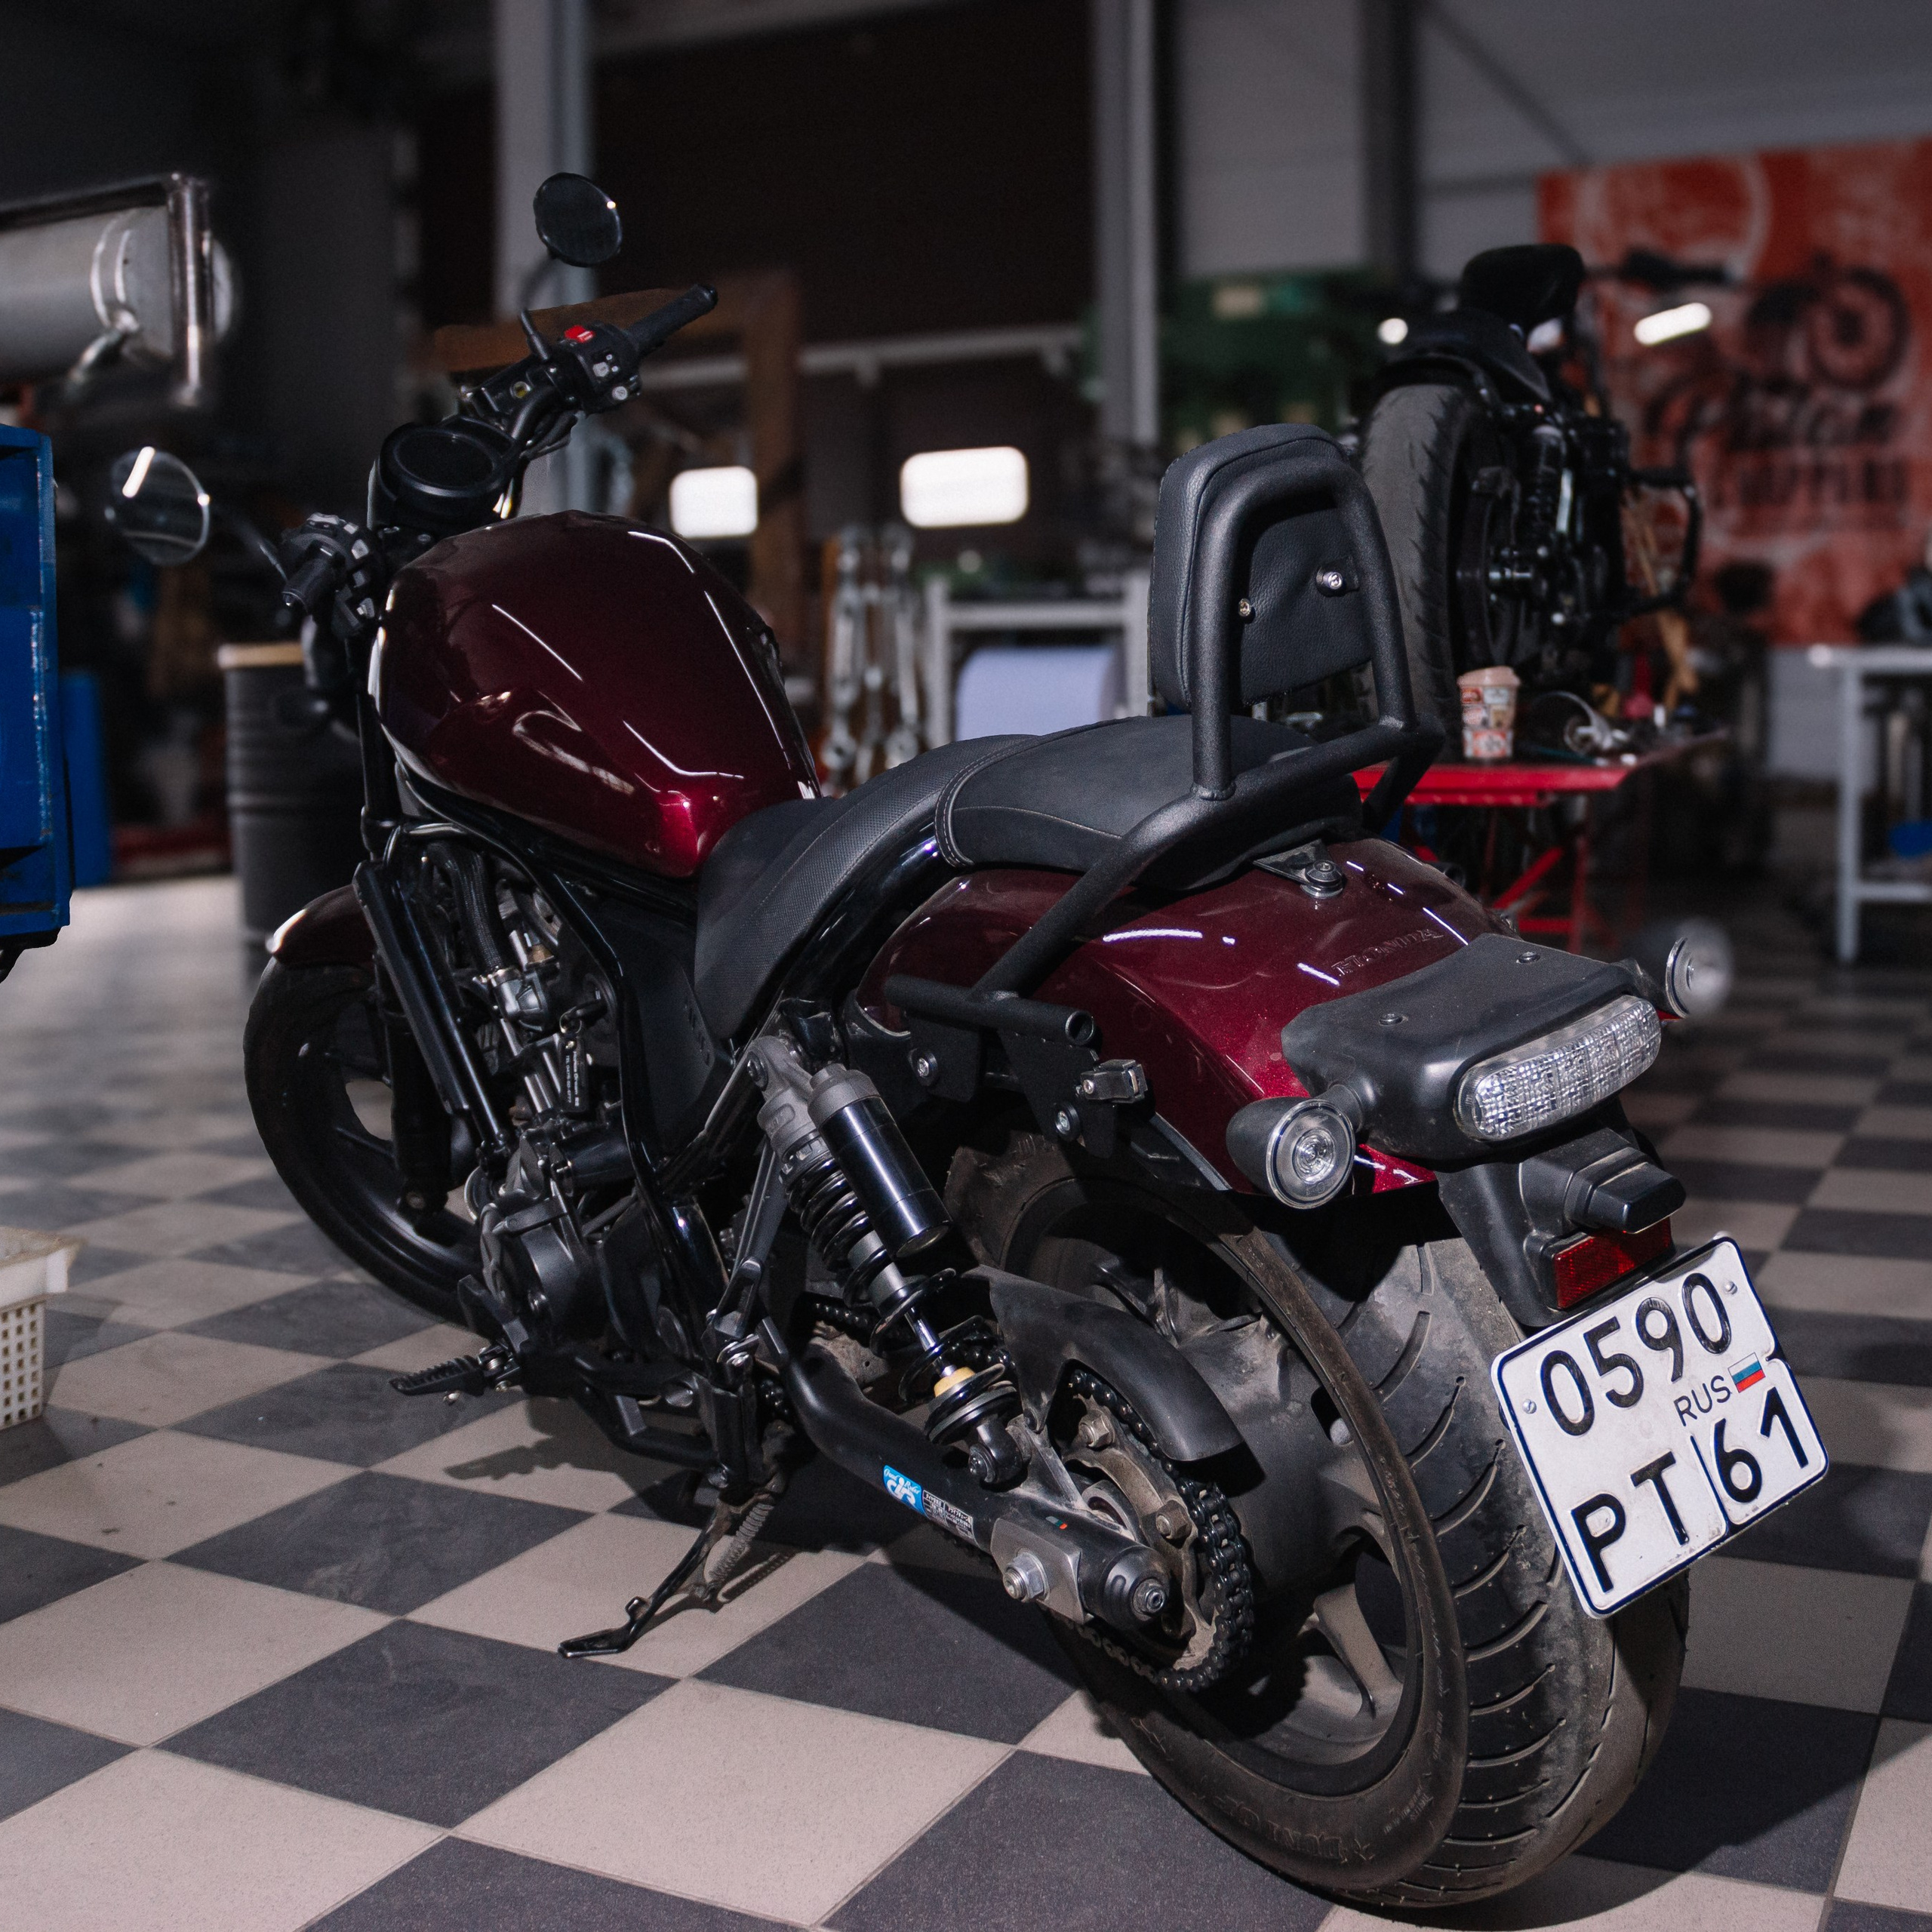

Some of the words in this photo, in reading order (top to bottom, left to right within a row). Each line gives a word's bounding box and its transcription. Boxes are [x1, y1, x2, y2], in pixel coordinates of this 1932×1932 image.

[1540, 1272, 1731, 1435] 0590
[1674, 1375, 1731, 1426] RUS
[1571, 1451, 1690, 1592] PT
[1710, 1387, 1809, 1503] 61
